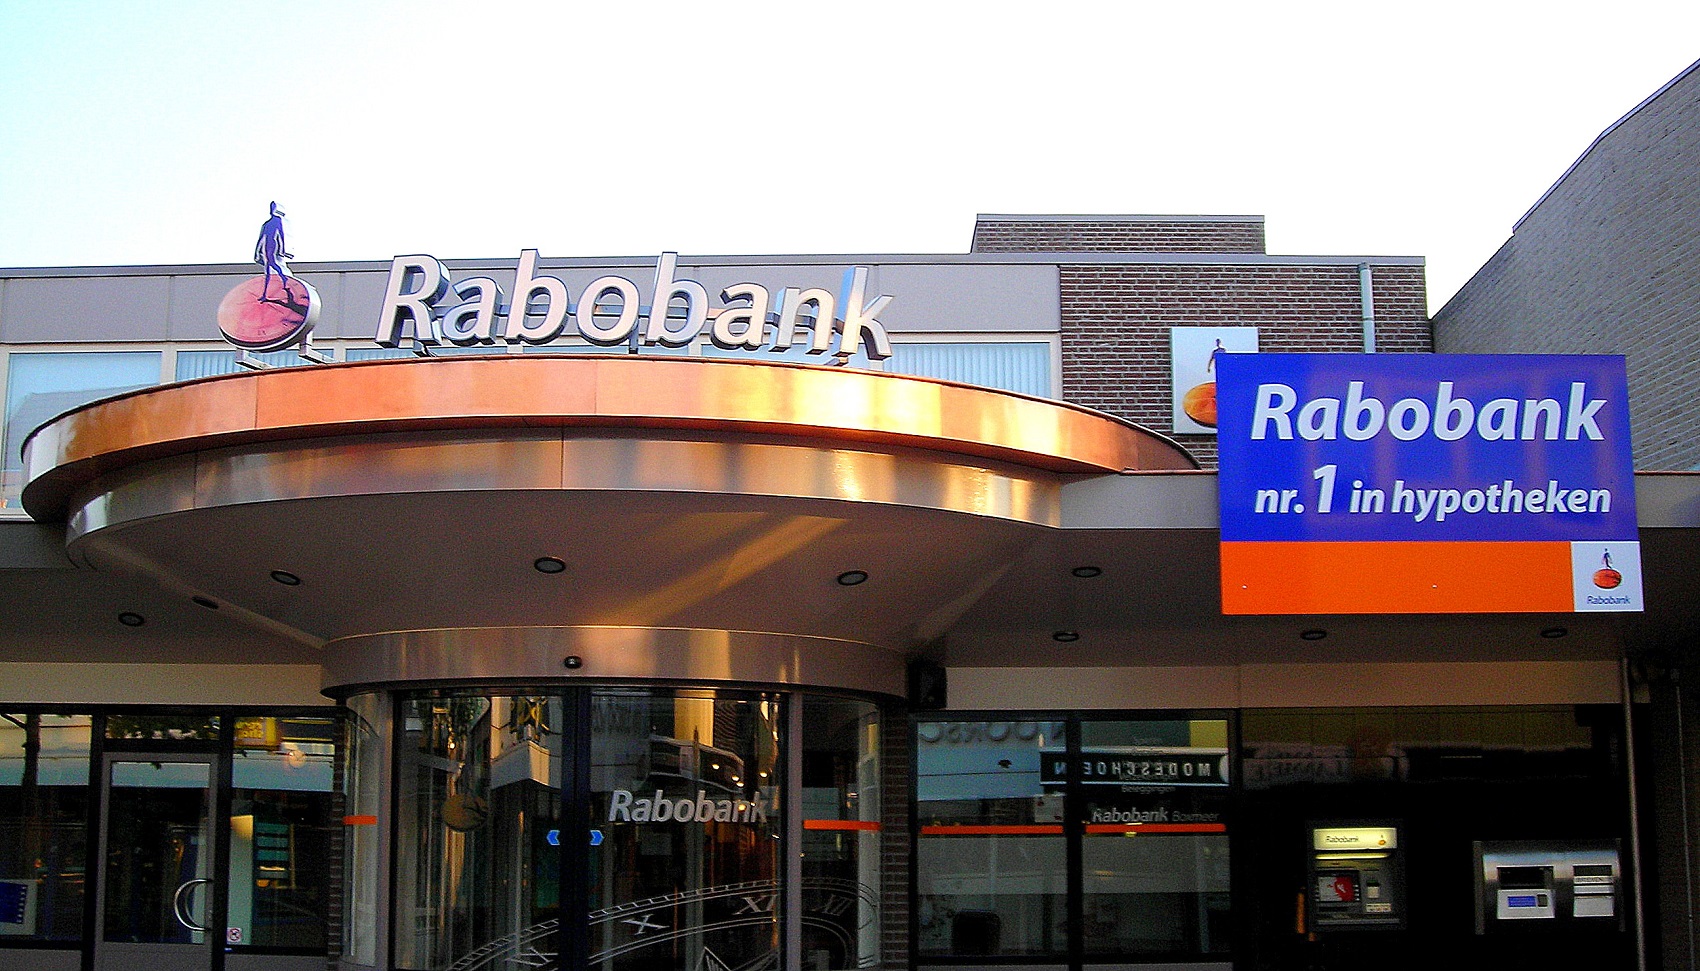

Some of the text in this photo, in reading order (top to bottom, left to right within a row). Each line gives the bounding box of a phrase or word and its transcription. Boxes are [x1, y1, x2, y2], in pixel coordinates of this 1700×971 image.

[375, 249, 894, 361] Rabobank
[1250, 381, 1608, 441] Rabobank
[1254, 464, 1612, 522] nr. 1 in hypotheken
[1586, 595, 1632, 605] Rabobank
[608, 789, 768, 824] Rabobank
[1091, 806, 1169, 823] Rabobank
